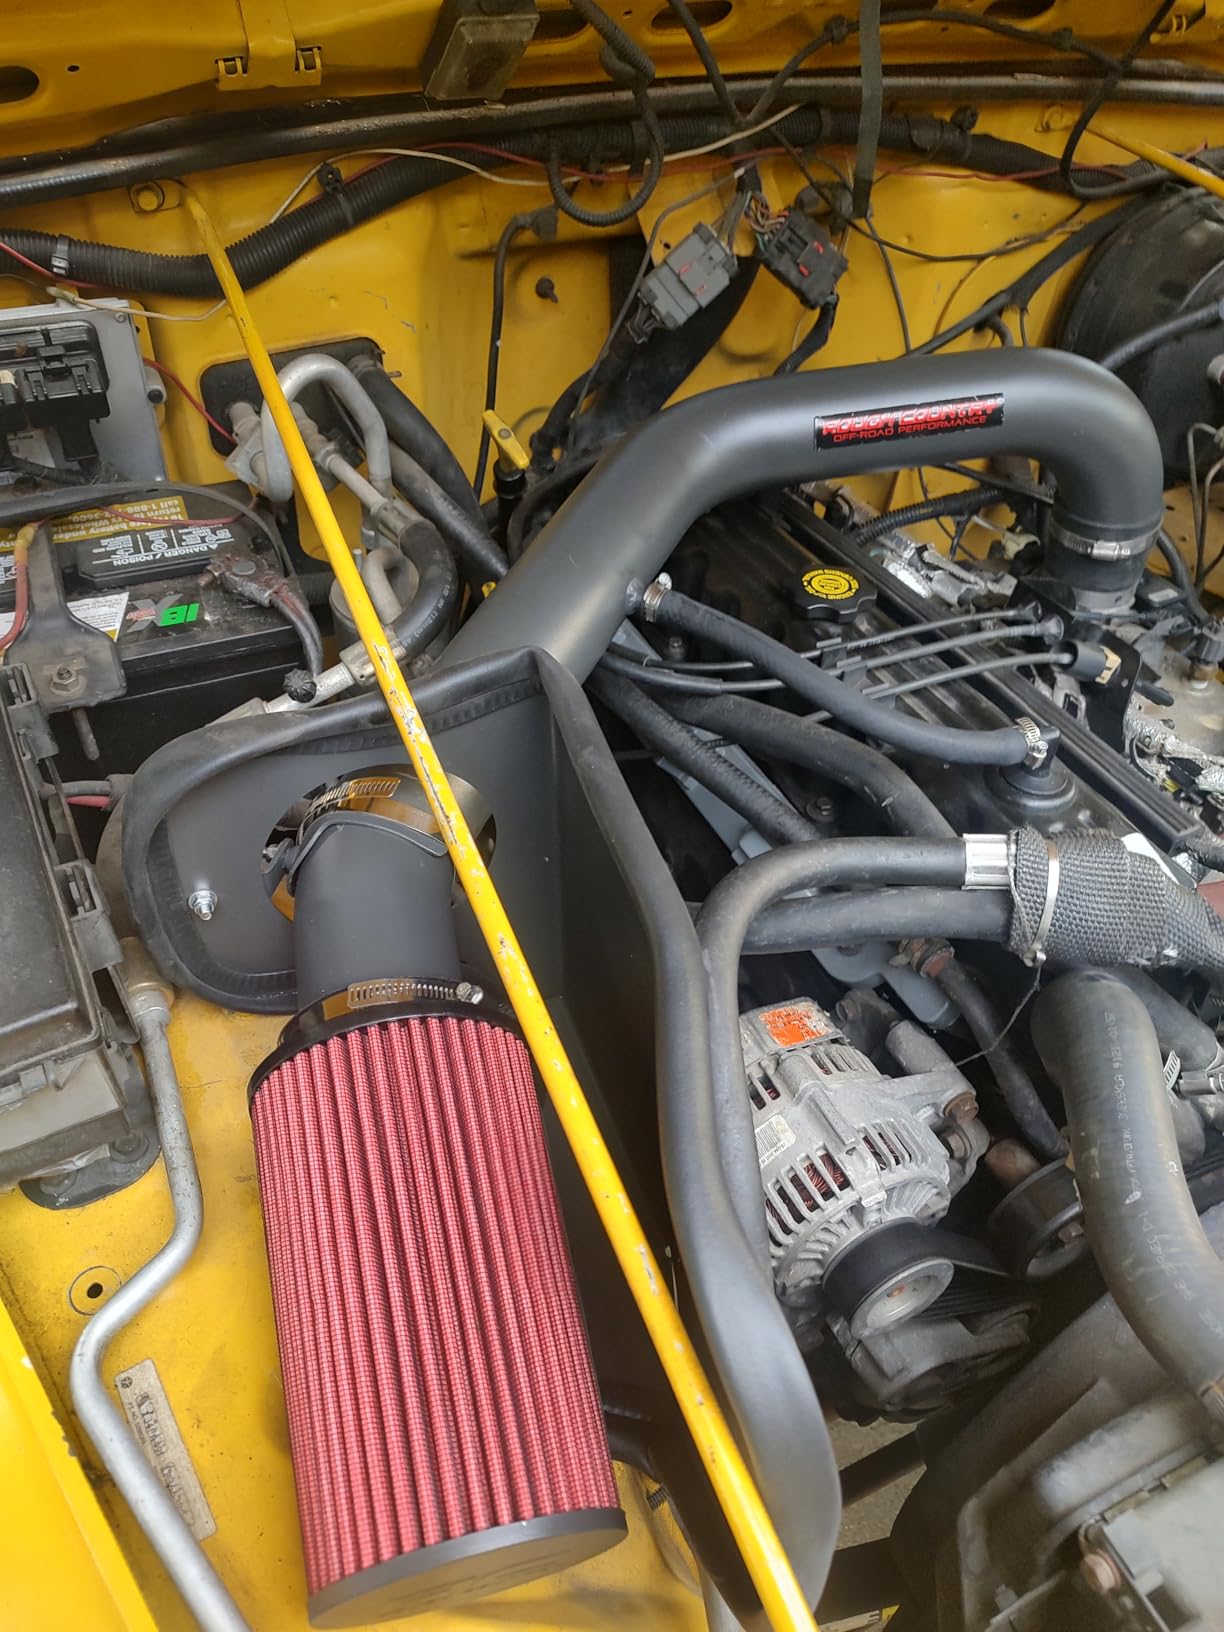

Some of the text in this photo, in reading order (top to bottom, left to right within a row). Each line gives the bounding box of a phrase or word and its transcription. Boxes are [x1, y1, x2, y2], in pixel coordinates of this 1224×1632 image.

[833, 415, 988, 443] OFF-ROAD PERFORMANCE
[164, 544, 208, 558] DANGER
[113, 555, 154, 567] POISON
